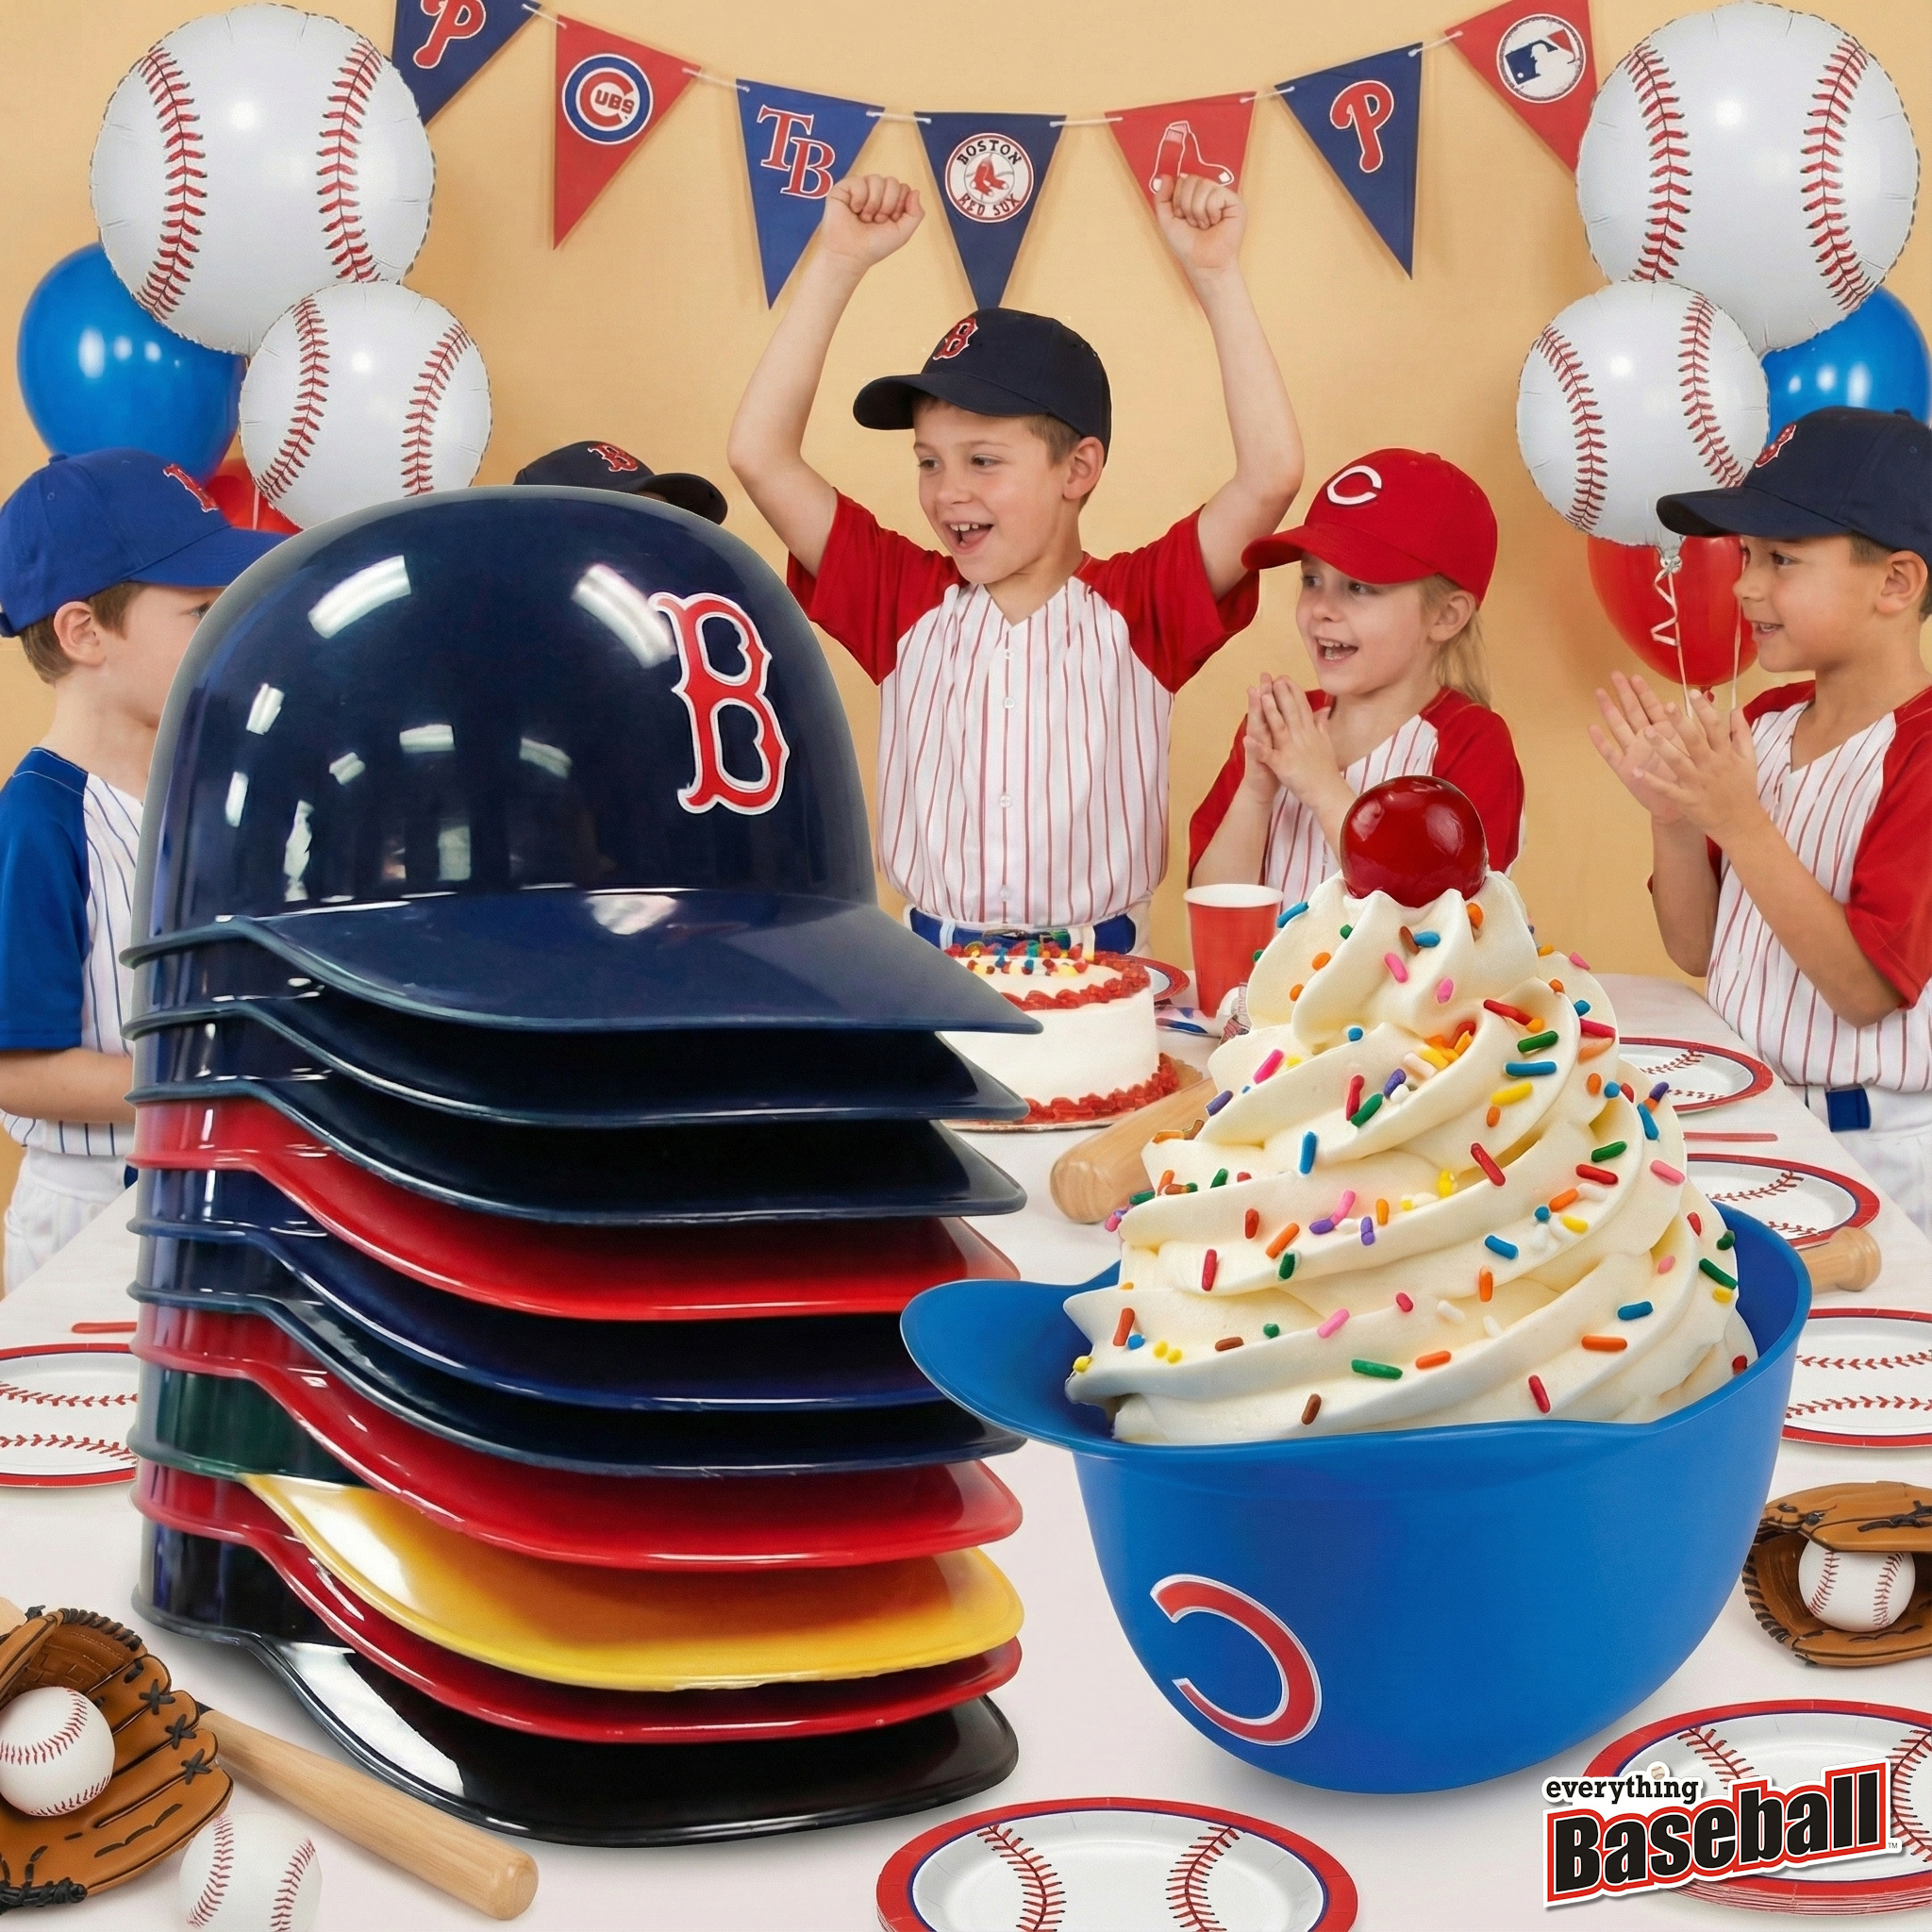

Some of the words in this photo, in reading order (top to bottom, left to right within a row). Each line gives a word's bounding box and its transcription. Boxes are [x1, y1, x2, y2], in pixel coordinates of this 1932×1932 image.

[413, 0, 487, 69] P
[1329, 79, 1395, 174] P
[757, 104, 836, 200] TB
[957, 139, 1022, 165] BOSTON
[958, 192, 985, 216] RED
[931, 316, 979, 360] B
[588, 442, 639, 473] B
[1326, 464, 1383, 505] C
[647, 591, 791, 816] B
